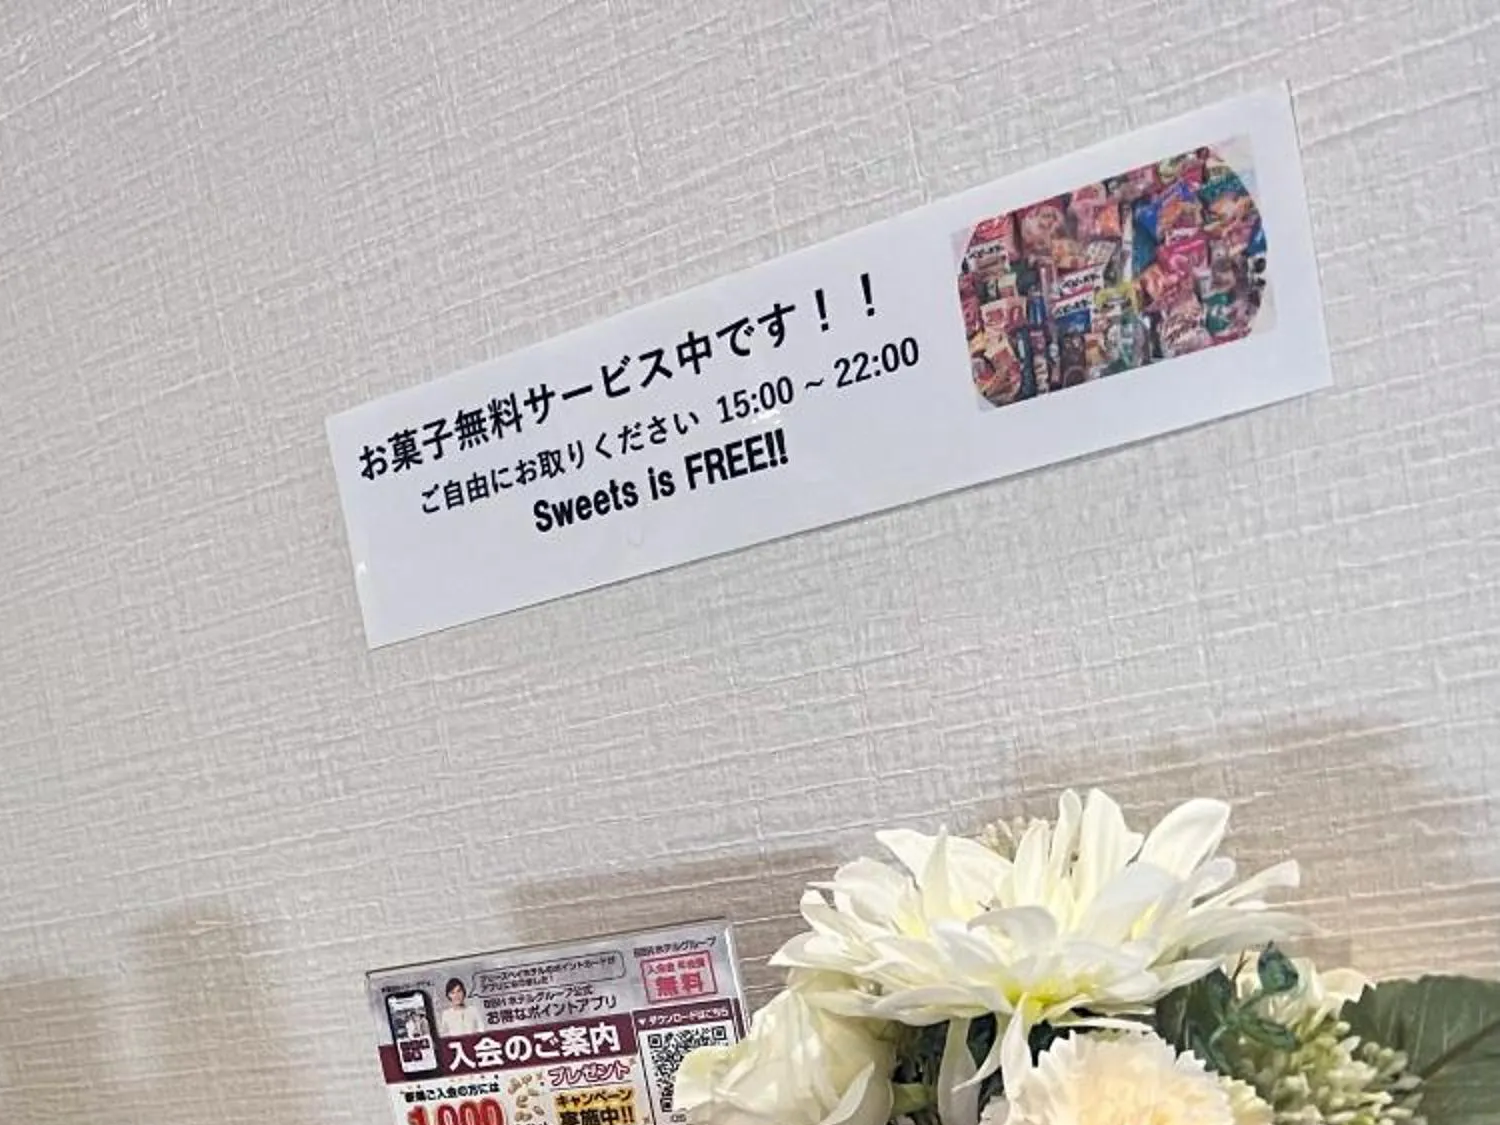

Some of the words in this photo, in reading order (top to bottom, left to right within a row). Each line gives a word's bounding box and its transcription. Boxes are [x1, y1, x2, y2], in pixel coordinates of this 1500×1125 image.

[420, 408, 701, 515] ご自由にお取りください
[715, 373, 795, 425] 15:00
[832, 336, 921, 390] 22:00
[532, 479, 639, 535] Sweets
[648, 463, 677, 503] is
[685, 430, 790, 492] FREE!!
[449, 1024, 621, 1071] 入会のご案内
[548, 1058, 631, 1086] プレゼント
[556, 1088, 633, 1107] キャンペーン
